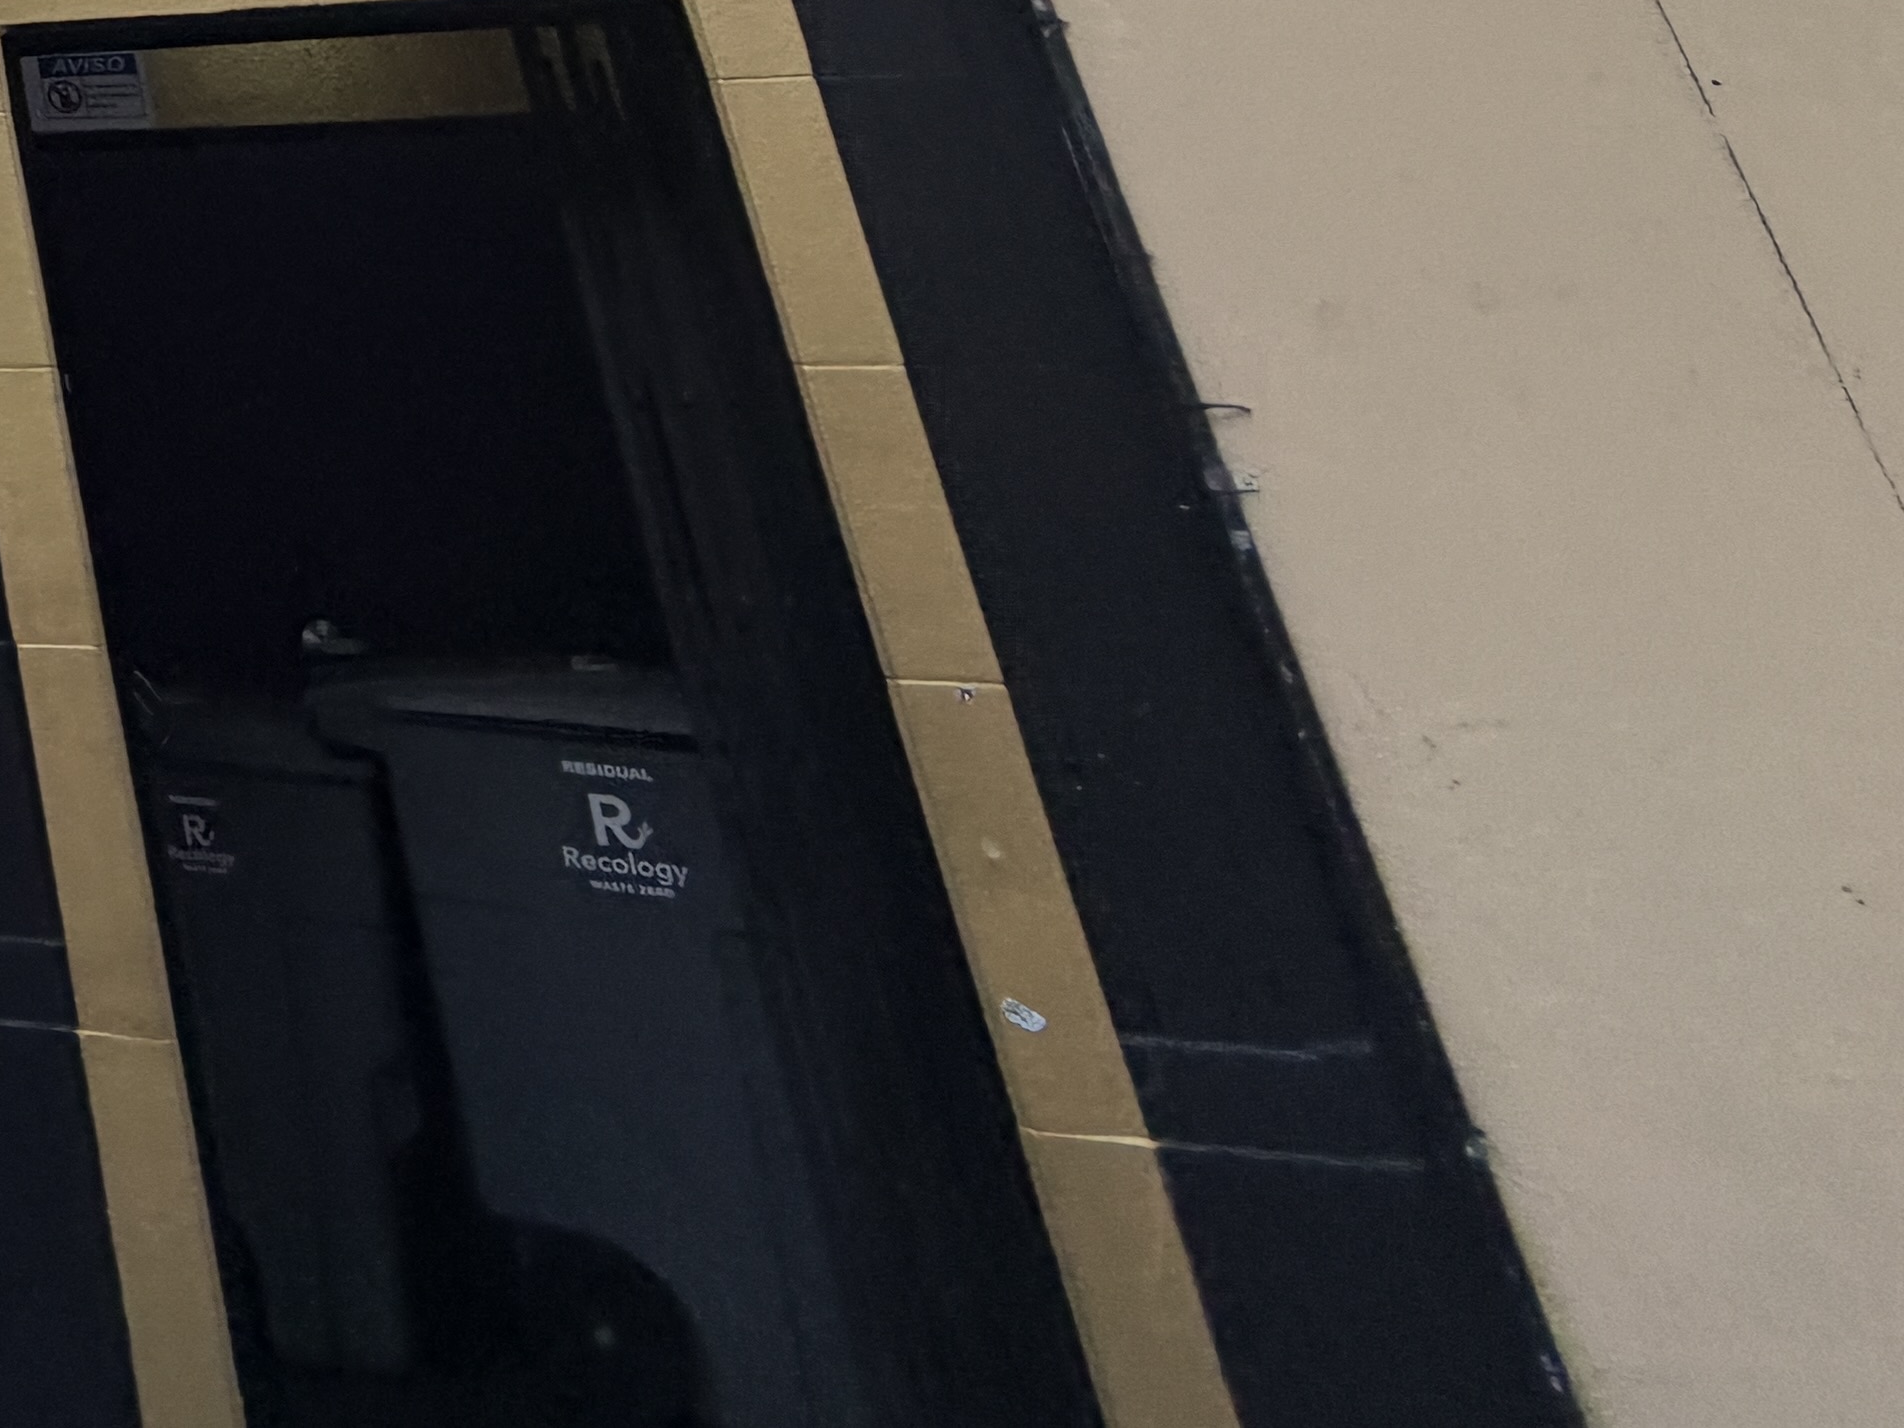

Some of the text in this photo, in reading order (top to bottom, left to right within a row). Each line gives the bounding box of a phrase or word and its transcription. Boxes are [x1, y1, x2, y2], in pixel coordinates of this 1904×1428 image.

[51, 55, 126, 76] AVISO
[560, 760, 654, 782] RESIDUAL
[561, 846, 689, 888] Recology
